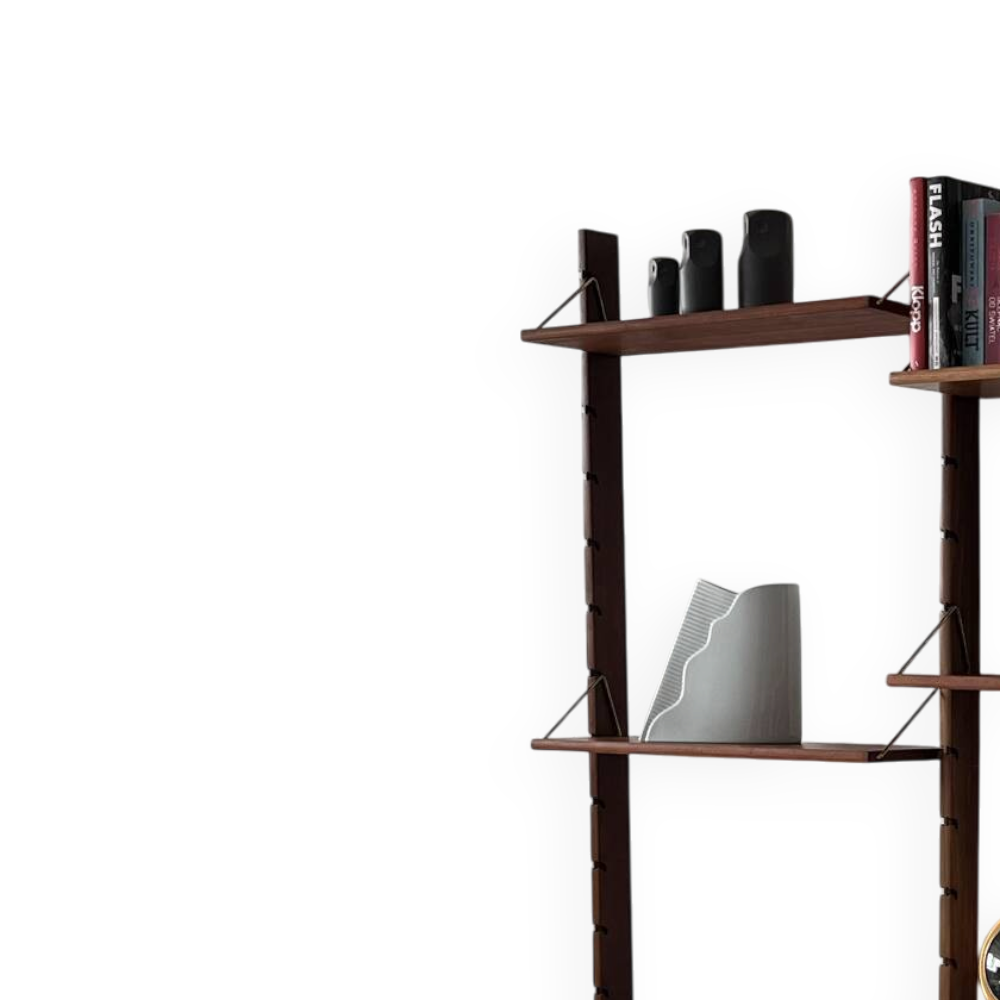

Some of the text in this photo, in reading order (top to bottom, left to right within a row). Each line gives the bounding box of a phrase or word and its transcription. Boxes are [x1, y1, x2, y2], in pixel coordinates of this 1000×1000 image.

[929, 183, 942, 249] FLASH
[911, 286, 924, 332] Klopp
[988, 296, 996, 308] OD
[965, 310, 979, 351] KULT
